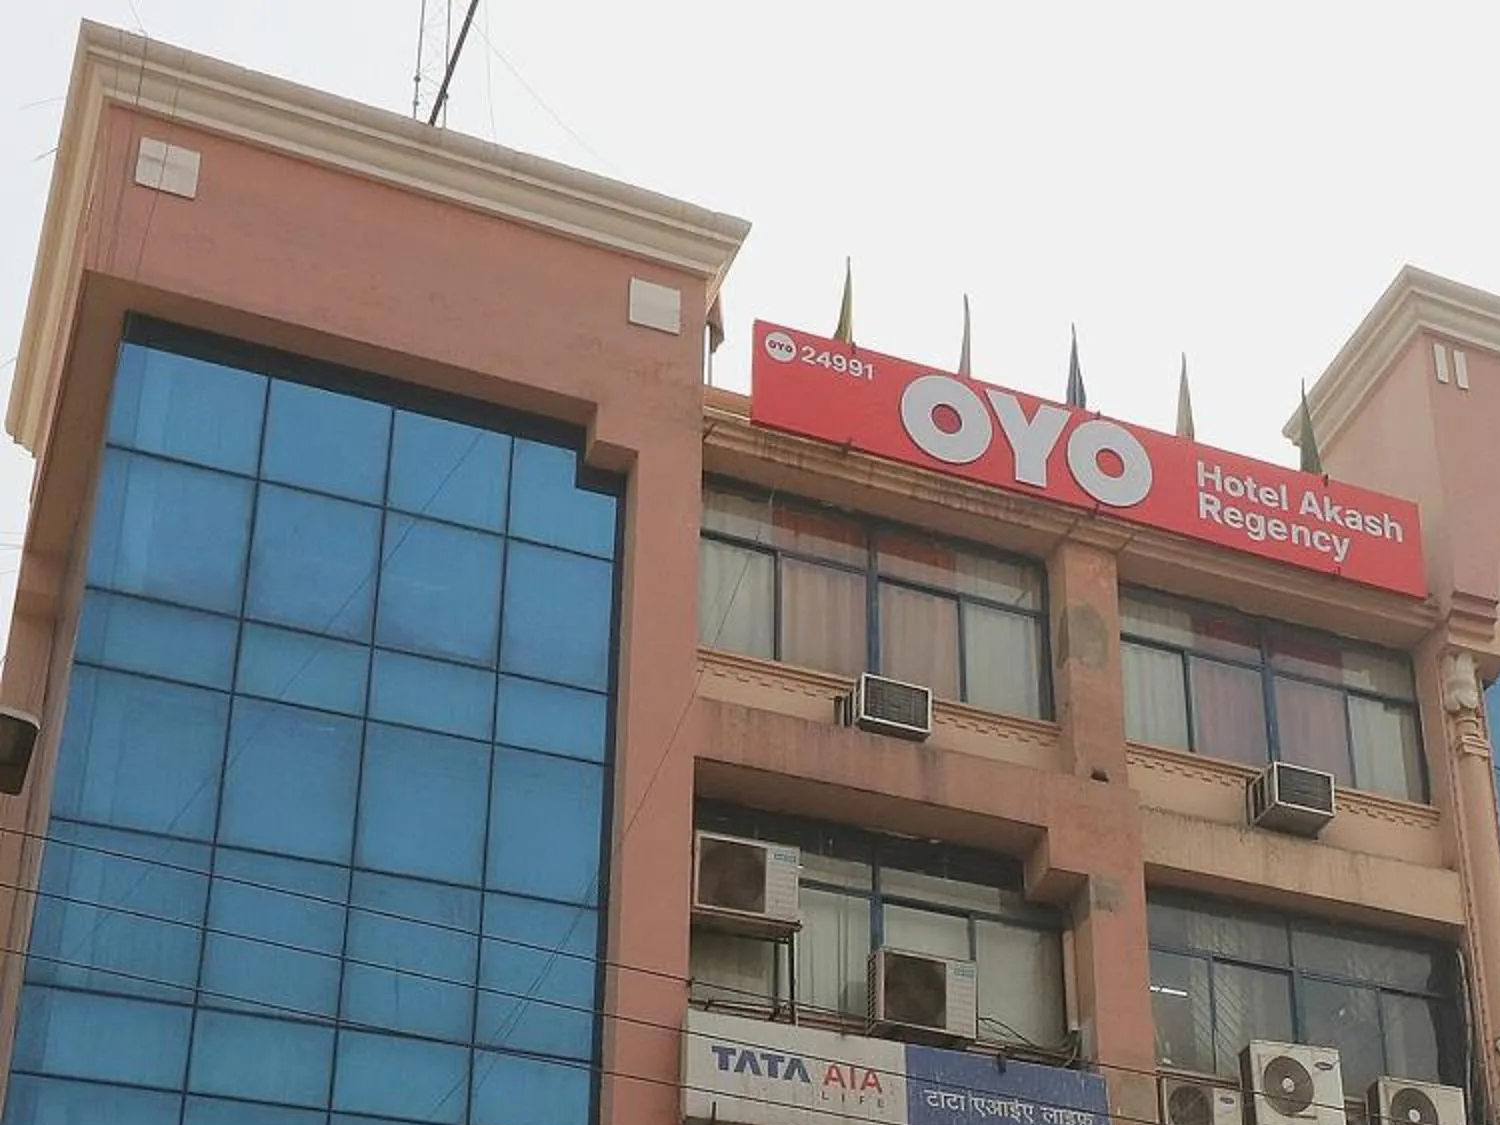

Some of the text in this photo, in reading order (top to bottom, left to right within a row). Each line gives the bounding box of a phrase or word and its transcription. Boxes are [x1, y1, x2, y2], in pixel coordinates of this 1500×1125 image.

[801, 345, 873, 380] 24991
[900, 375, 1152, 507] OYO
[1197, 461, 1404, 543] Hotel Akash
[1198, 491, 1350, 562] Regency
[711, 1045, 883, 1094] TATA AIA
[923, 1089, 966, 1111] टाटा
